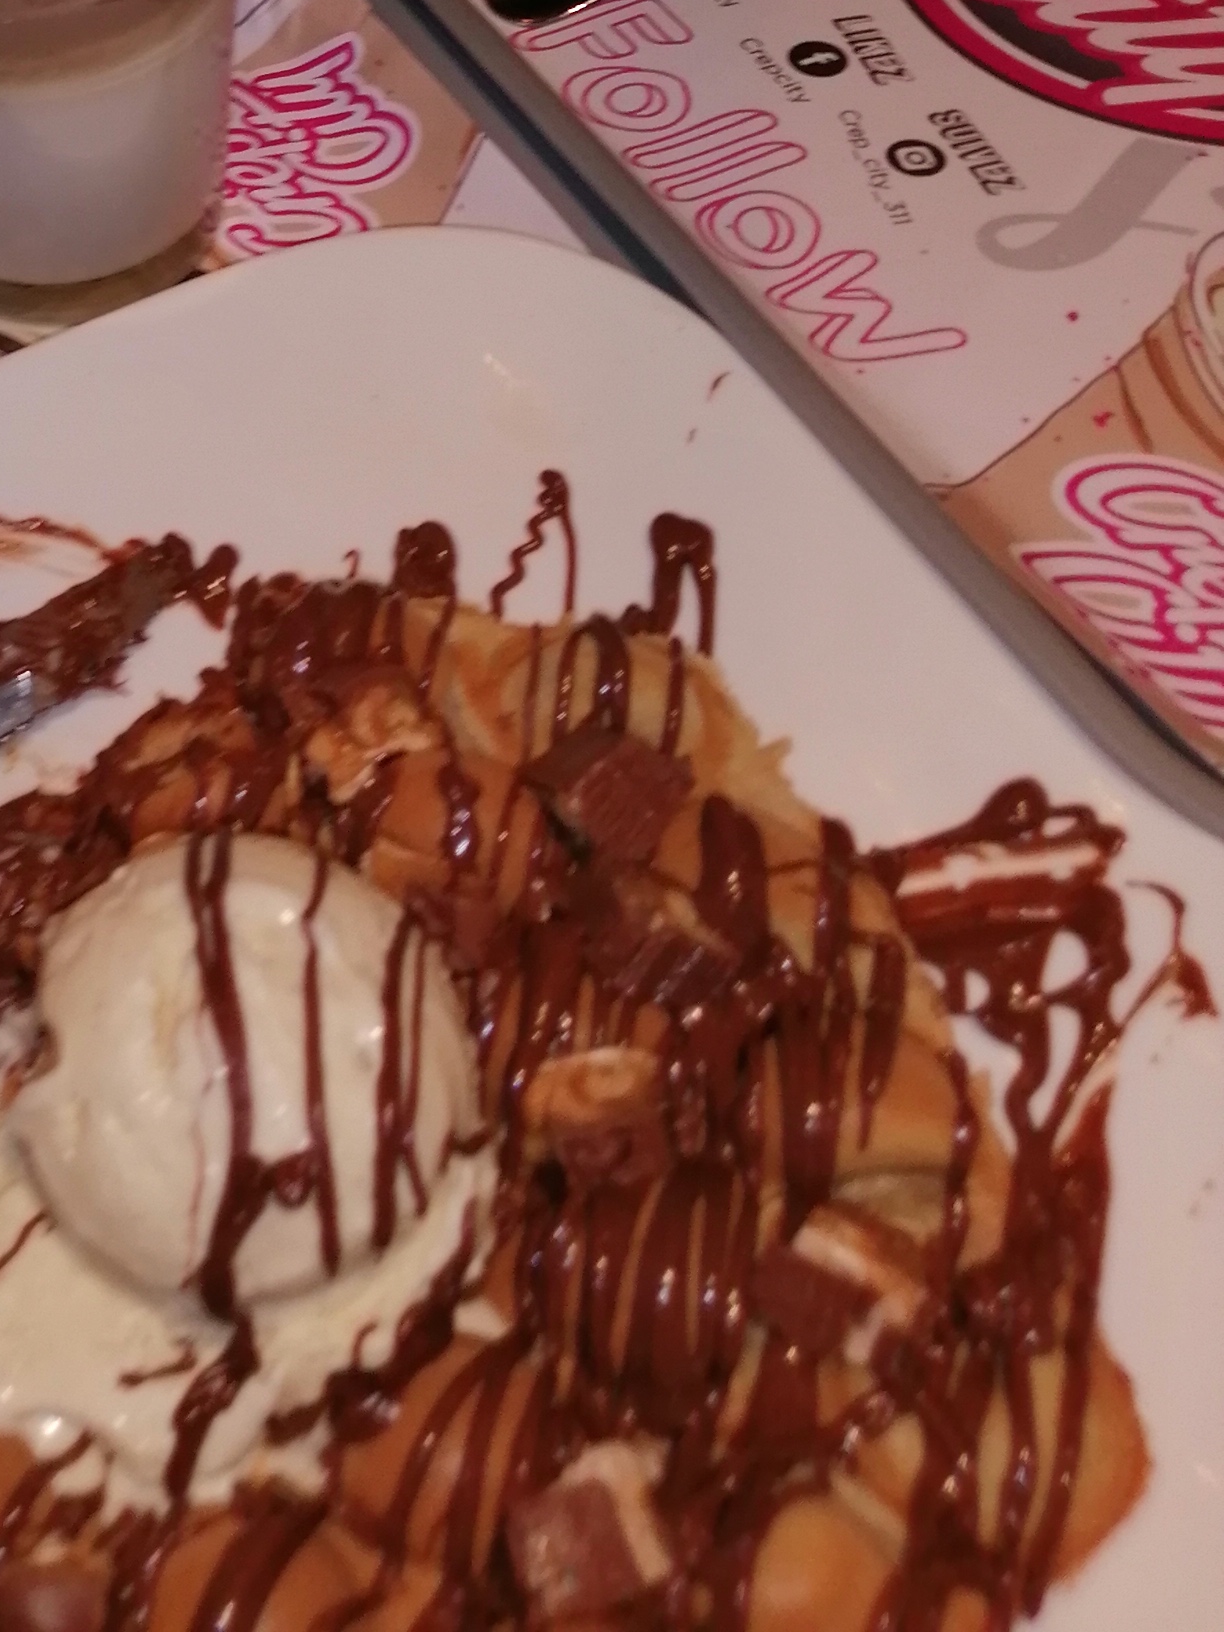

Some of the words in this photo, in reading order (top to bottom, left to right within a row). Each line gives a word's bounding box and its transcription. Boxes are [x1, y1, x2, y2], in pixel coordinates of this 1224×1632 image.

[739, 36, 811, 104] Crepcity
[831, 14, 914, 87] LIKEZ
[927, 108, 1026, 197] SUIVEZ
